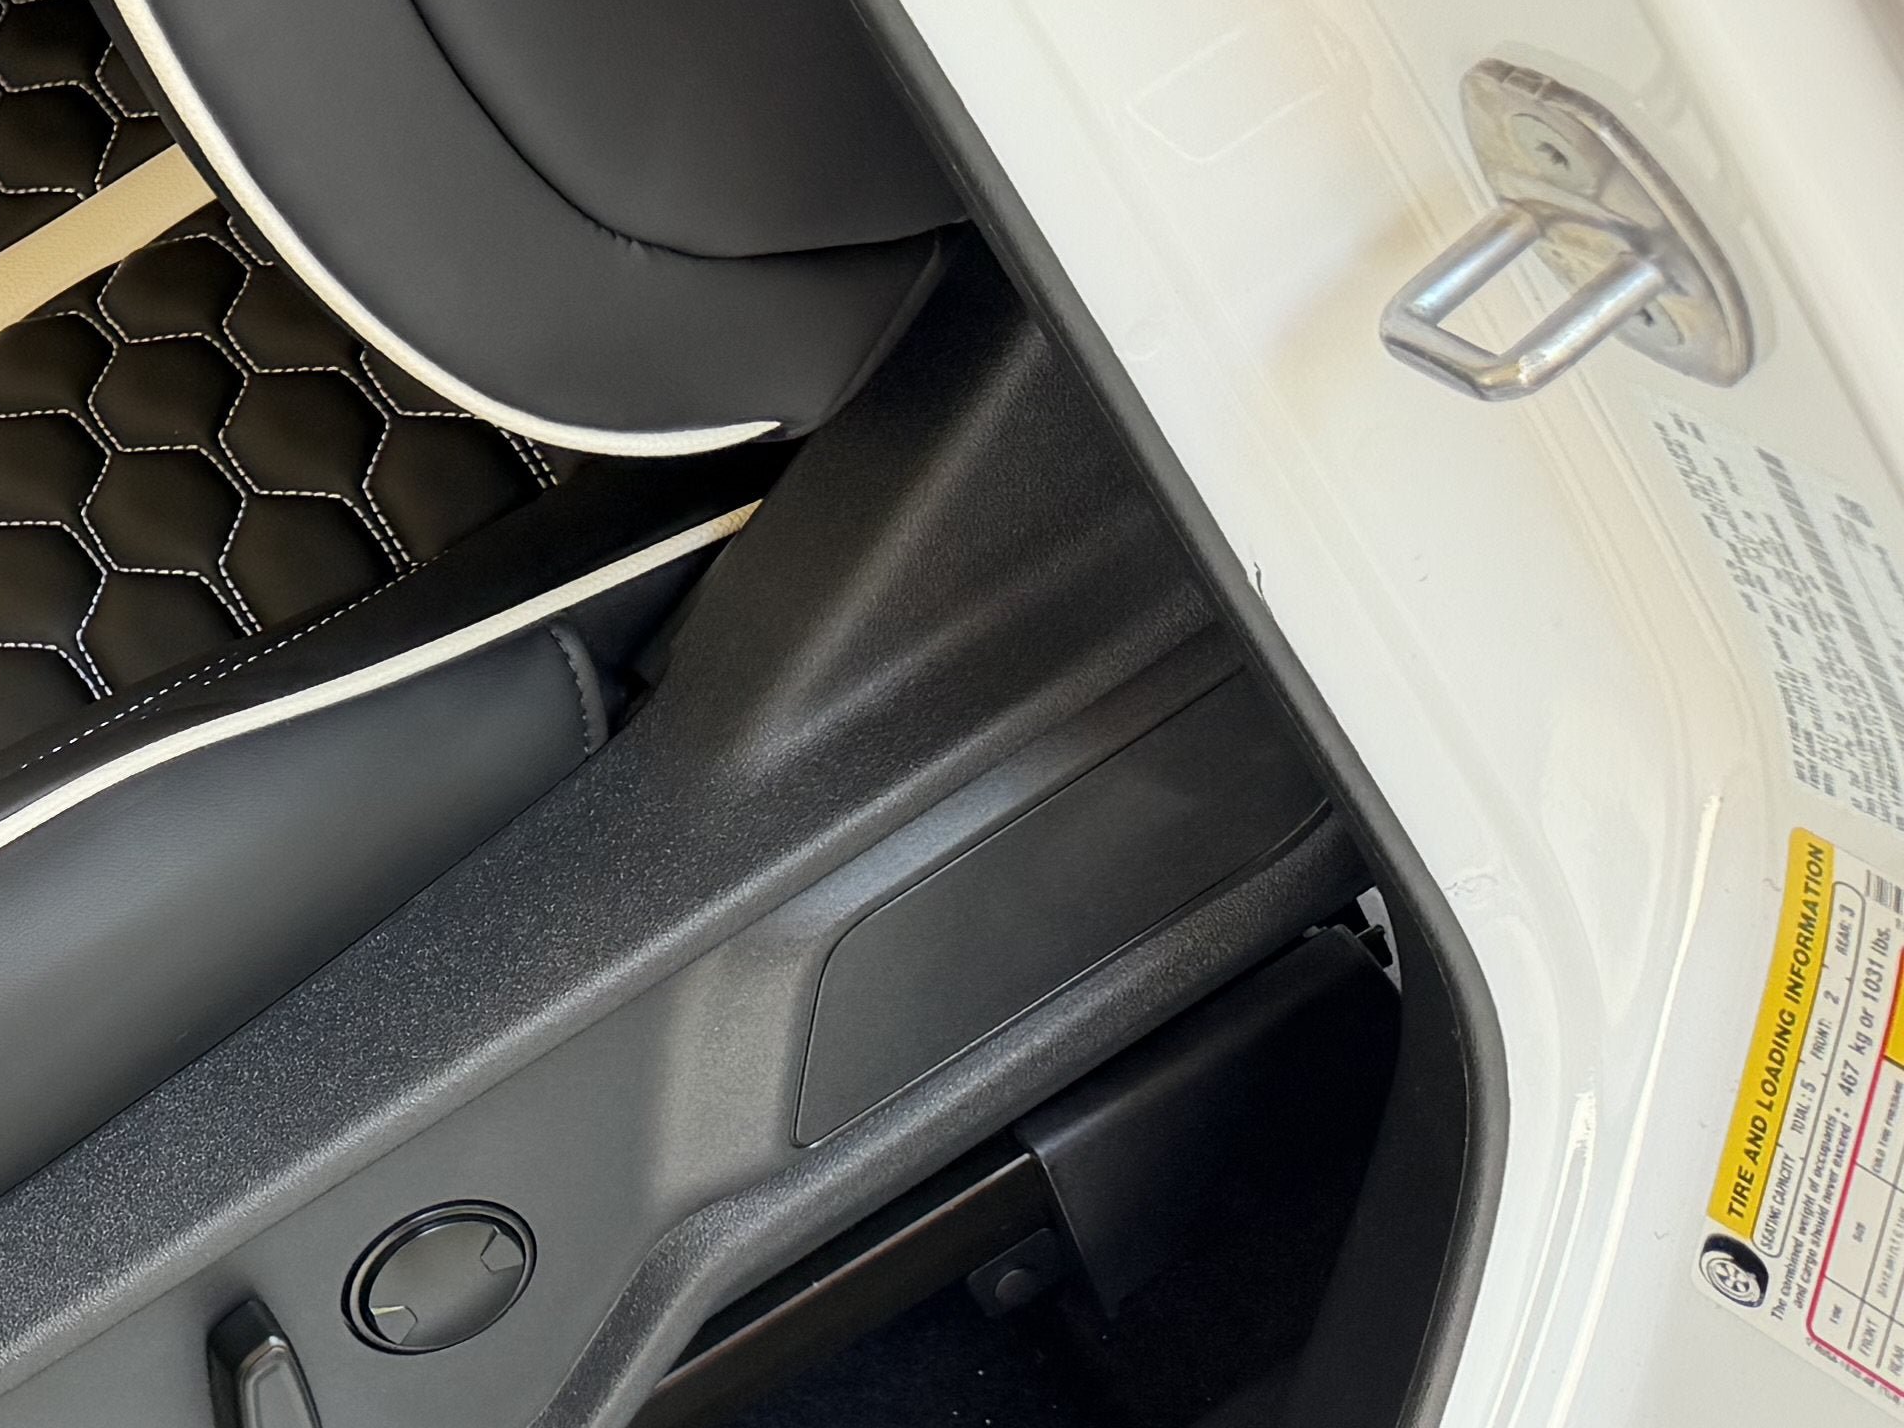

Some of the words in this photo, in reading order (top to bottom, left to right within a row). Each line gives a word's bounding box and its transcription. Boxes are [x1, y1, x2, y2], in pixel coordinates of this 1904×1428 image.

[1783, 841, 1826, 1006] INFORMATION
[1840, 904, 1856, 918] 3
[1869, 926, 1892, 959] lbs.
[1824, 989, 1841, 1005] 2
[1861, 956, 1887, 1004] 1031
[1858, 1006, 1875, 1029] or
[1757, 1008, 1797, 1112] LOADING
[1848, 1031, 1873, 1056] kg
[1801, 1080, 1816, 1094] 5
[1837, 1059, 1860, 1097] 467
[1747, 1118, 1769, 1169] AND
[1727, 1167, 1754, 1219] TIRE
[1759, 1203, 1782, 1251] SEATING
[1772, 1151, 1796, 1206] CAPACITY
[1771, 1298, 1788, 1322] The
[1781, 1235, 1804, 1297] combined
[1796, 1193, 1816, 1237] weight
[1808, 1176, 1819, 1194] of
[1814, 1113, 1837, 1178] occupants
[1793, 1283, 1808, 1309] and
[1801, 1248, 1819, 1283] cargo
[1810, 1204, 1830, 1248] should
[1823, 1168, 1840, 1206] never
[1833, 1122, 1852, 1168] exceed
[1858, 1317, 1879, 1358] FRONT
